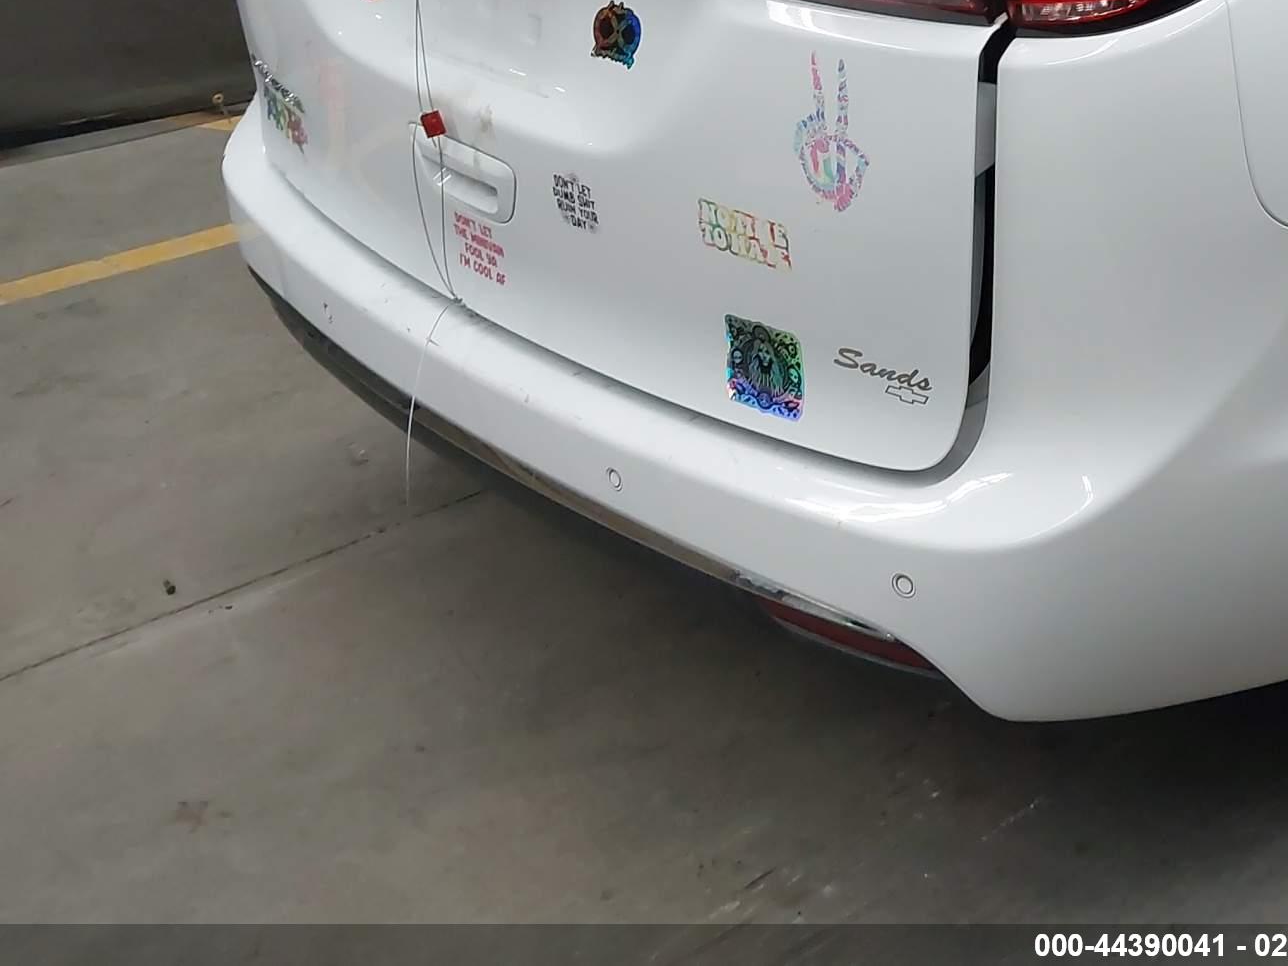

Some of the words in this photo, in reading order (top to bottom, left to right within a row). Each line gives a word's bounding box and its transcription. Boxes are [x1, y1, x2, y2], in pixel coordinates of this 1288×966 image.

[552, 186, 576, 204] DUMB
[577, 195, 595, 210] SHIT
[576, 183, 591, 199] LET
[557, 198, 577, 215] RUIN
[578, 207, 599, 225] YOUR
[570, 214, 587, 230] DAY
[465, 242, 485, 262] FOOL
[473, 260, 493, 280] COOL
[833, 346, 933, 392] Sands
